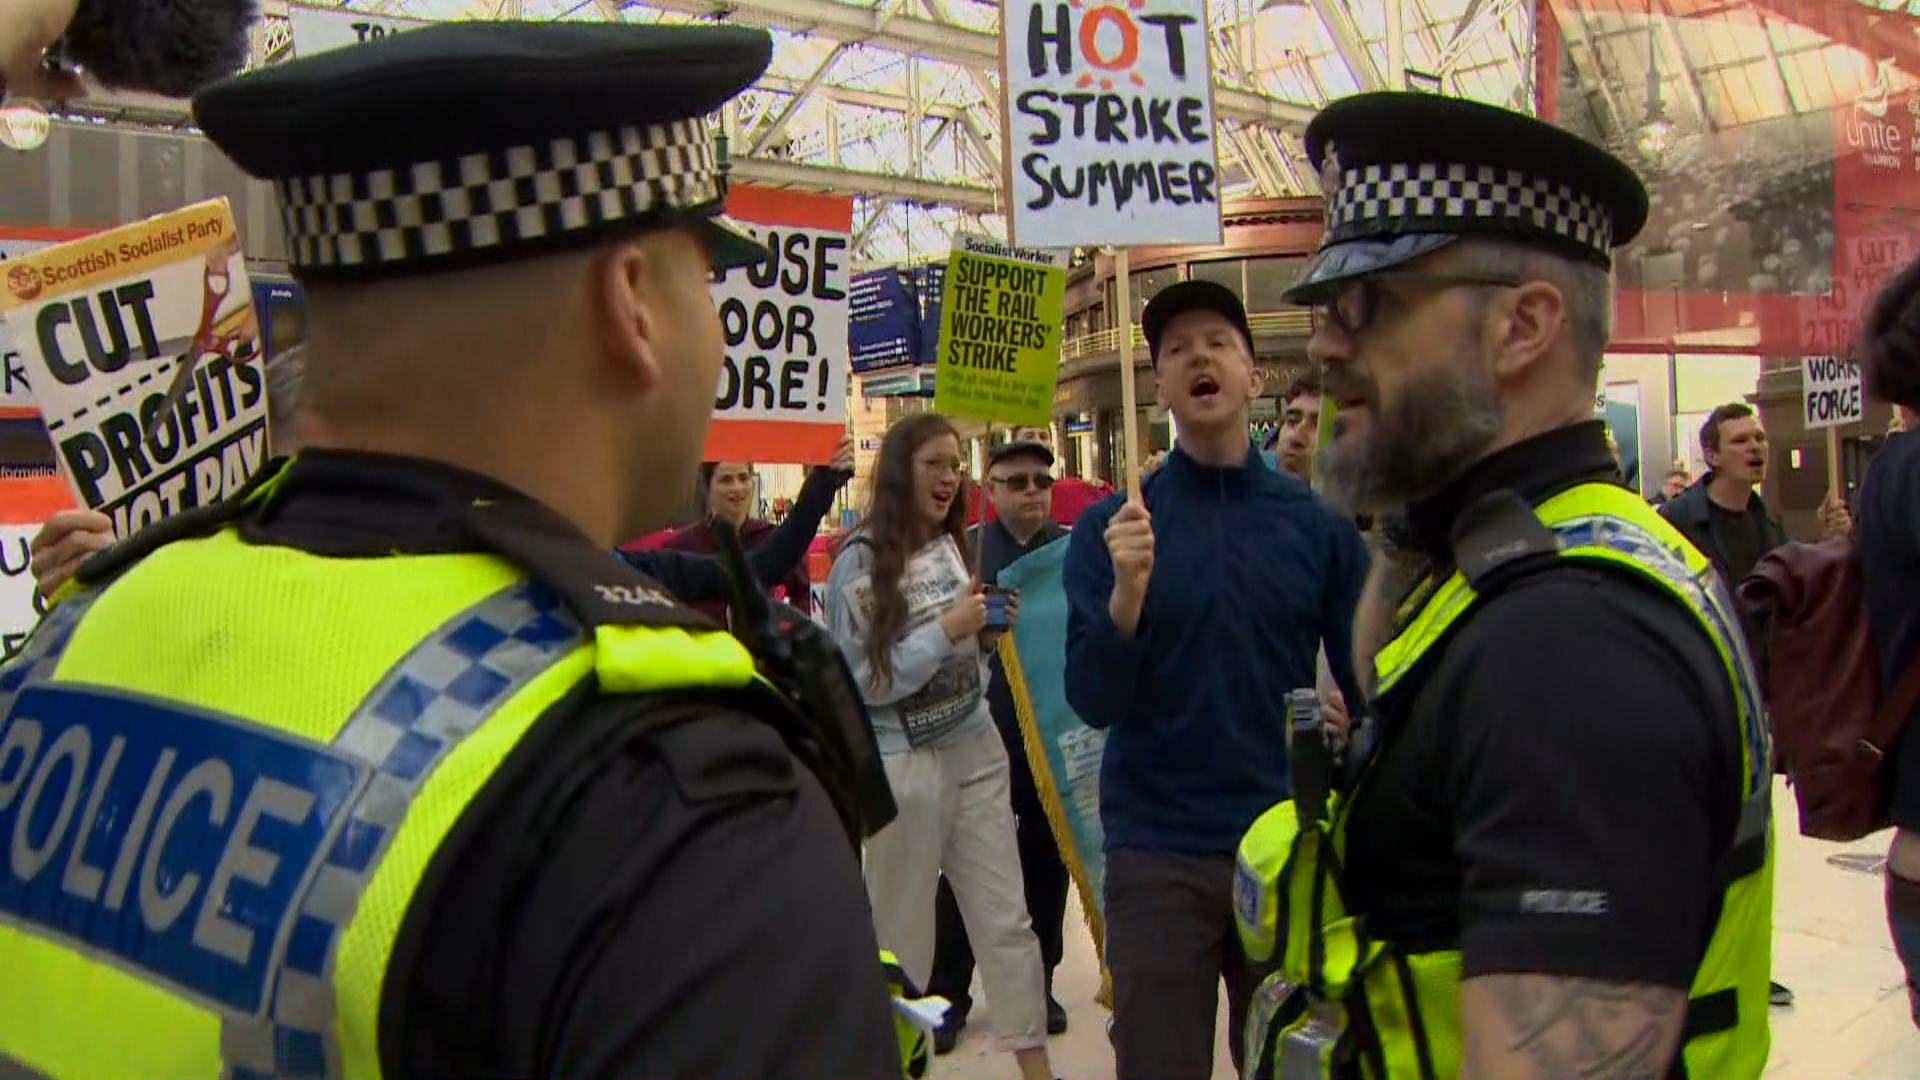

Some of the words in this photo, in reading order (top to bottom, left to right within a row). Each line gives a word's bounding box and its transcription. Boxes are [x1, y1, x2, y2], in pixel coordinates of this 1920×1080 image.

[1026, 2, 1198, 82] HOT
[1016, 89, 1210, 146] STRIKE
[1021, 152, 1217, 212] SUMMER
[42, 248, 117, 286] Scottish
[118, 228, 185, 263] Socialist
[187, 216, 224, 241] Party
[714, 230, 847, 300] USE
[956, 256, 1048, 296] SUPPORT
[964, 237, 1012, 257] Socialist
[1015, 248, 1055, 265] Worker
[35, 279, 161, 386] CUT
[718, 297, 818, 356] OOR
[951, 311, 1051, 350] WORKERS'
[954, 285, 990, 314] THE
[997, 291, 1040, 321] RAIL
[948, 339, 1018, 373] STRIKE
[59, 348, 263, 510] PROFITS
[1807, 385, 1860, 422] FORCE
[194, 427, 266, 508] PAY
[0, 718, 318, 966] POLICE
[1520, 889, 1608, 914] POLICE
